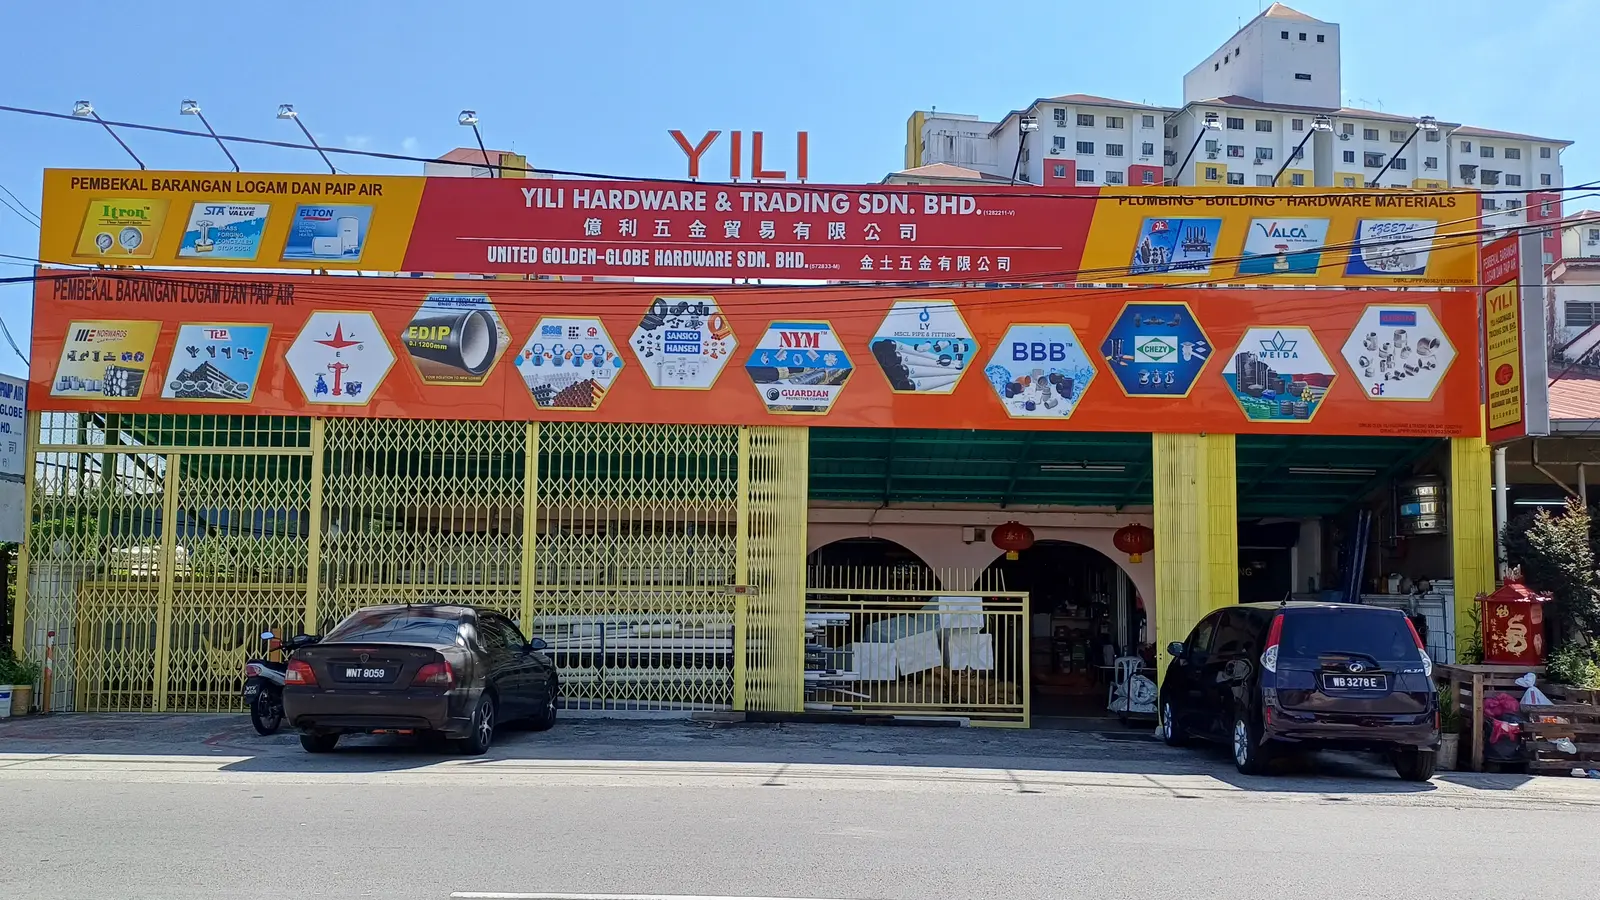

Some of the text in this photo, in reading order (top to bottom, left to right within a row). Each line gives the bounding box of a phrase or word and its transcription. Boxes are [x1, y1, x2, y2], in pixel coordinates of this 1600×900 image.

[668, 130, 808, 180] YILI
[71, 177, 383, 196] PEMBEKAL BARANGAN LOGAM DAN PAIP AIR
[520, 187, 564, 208] YILI
[573, 189, 706, 212] HARDWARE
[714, 191, 732, 211] &
[740, 191, 849, 215] TRADING
[858, 194, 916, 215] SDN.
[924, 195, 982, 216] BHD.
[1118, 195, 1456, 208] PLUMBING BUILDING HARDWARE MATERIALS
[102, 205, 147, 220] Itron
[204, 206, 226, 216] STA
[300, 209, 334, 217] ELTON
[583, 217, 917, 241] 億利五金貿易有限公司
[1256, 222, 1307, 238] VALCA
[488, 246, 537, 264] UNITED
[542, 247, 649, 267] GOLDEN-GLOBE
[654, 249, 732, 268] HARDWARE
[737, 250, 770, 268] SDN.
[775, 251, 809, 270] BHD.
[860, 254, 1011, 272] 金土五金有限公司
[53, 279, 295, 305] PEMBEKAL BARANGAN LOGAM DAN PAIP AIR
[1490, 290, 1513, 314] YILI
[96, 330, 128, 338] NORWARDS
[408, 326, 451, 341] EDIP
[666, 332, 699, 341] SANSICO
[779, 331, 820, 348] NYM
[418, 342, 447, 351] 1200mm
[666, 345, 699, 353] HANSEN
[1012, 342, 1067, 361] BBB
[1144, 346, 1168, 354] CHEZY
[1259, 351, 1299, 359] WEIDA
[14, 385, 24, 402] AIR
[781, 389, 829, 397] GUARDIAN
[0, 403, 23, 419] GLOBE
[346, 668, 385, 679] WNT 8059
[1333, 678, 1377, 688] WB 3278 E
